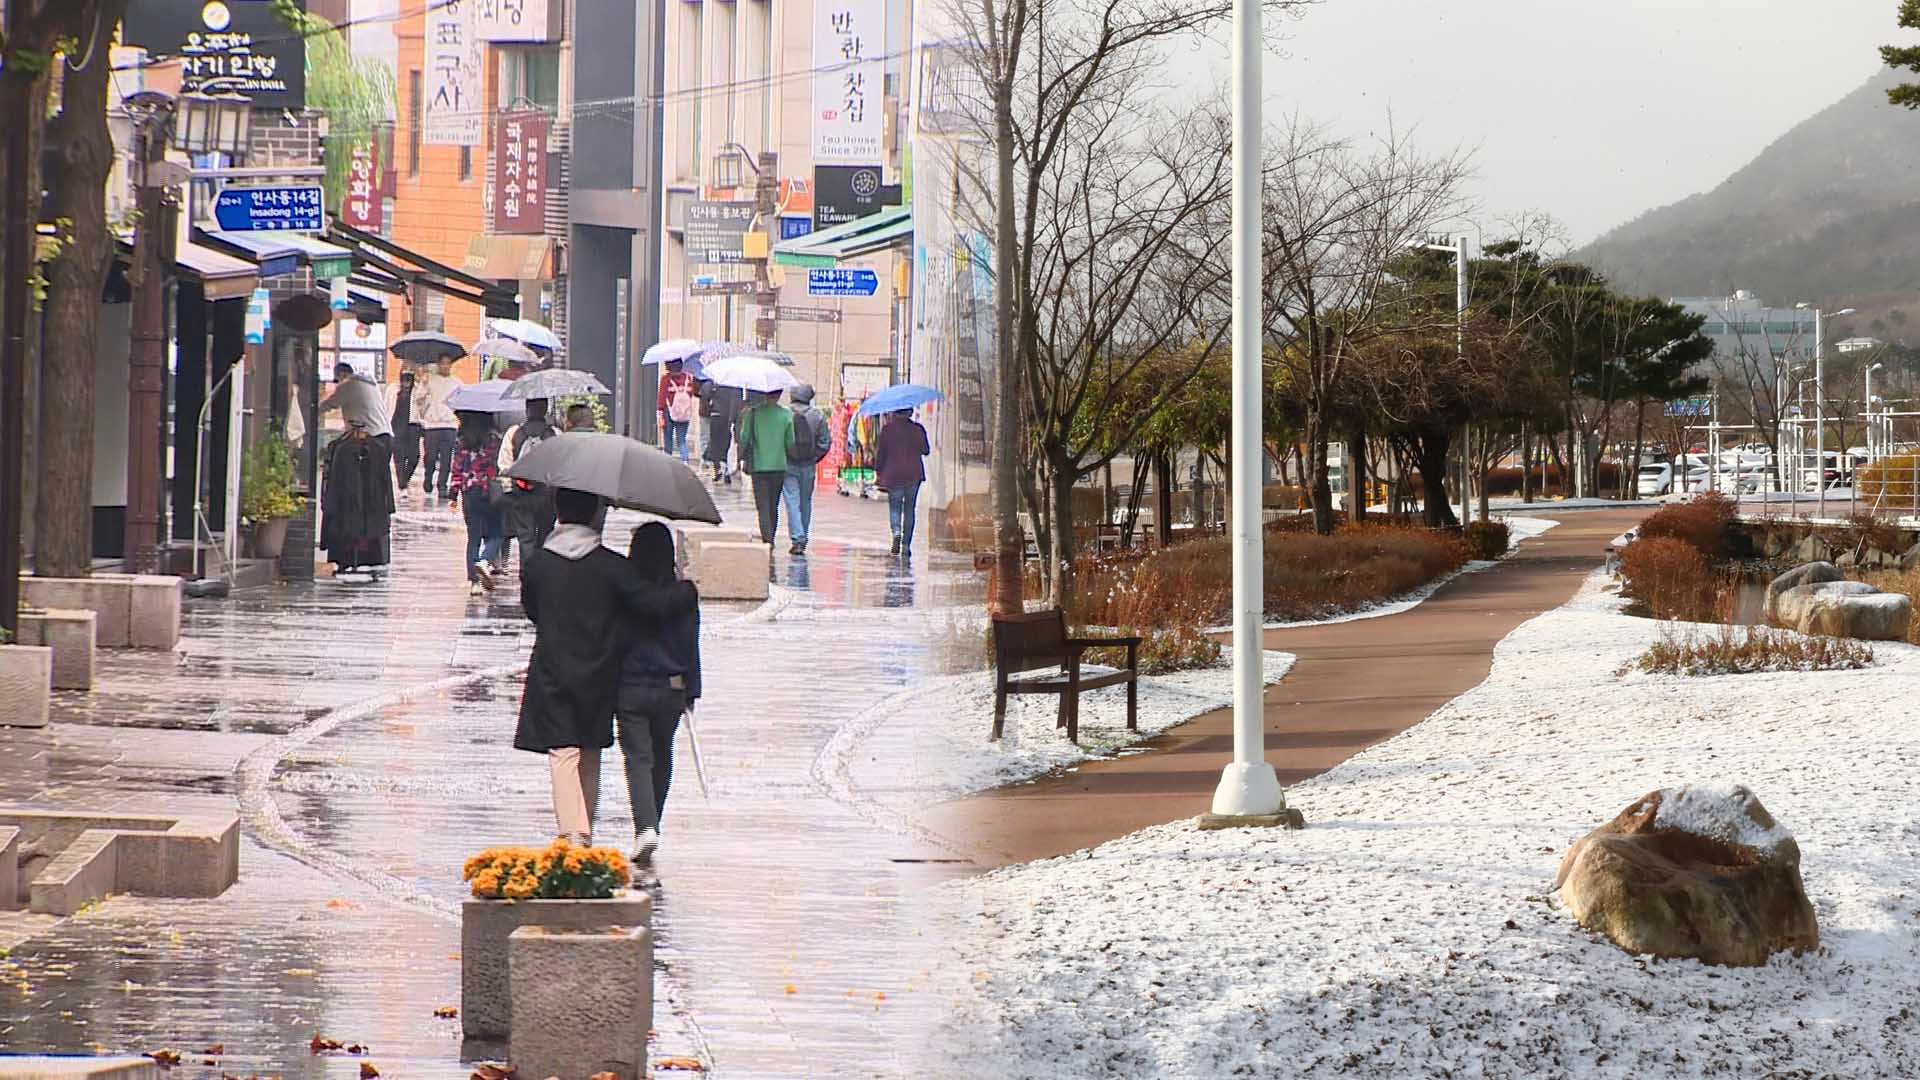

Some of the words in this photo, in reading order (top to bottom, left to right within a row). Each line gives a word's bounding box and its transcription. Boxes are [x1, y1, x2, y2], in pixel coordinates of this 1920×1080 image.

[230, 56, 275, 77] 인형
[844, 136, 876, 145] House
[821, 146, 850, 156] Since
[251, 190, 319, 206] 인사동14길
[249, 207, 291, 218] Insadong
[294, 205, 320, 217] 14-gil
[691, 206, 717, 219] 인사동
[819, 205, 835, 214] TEA
